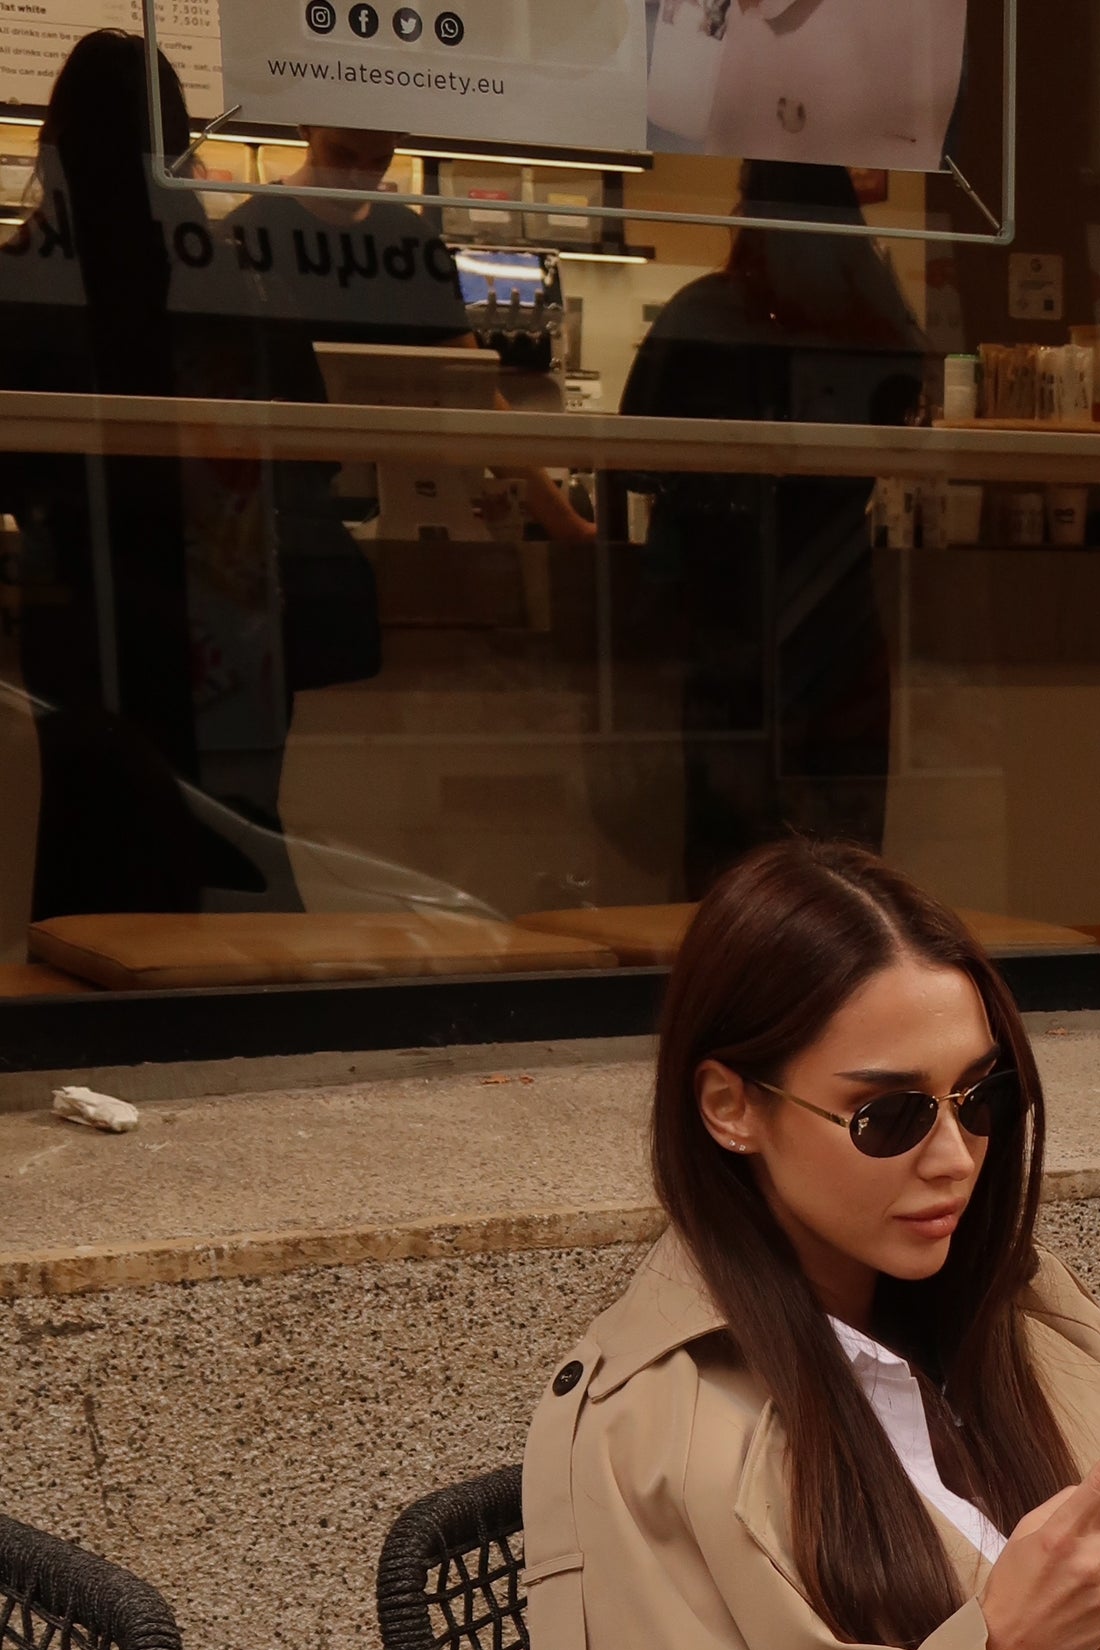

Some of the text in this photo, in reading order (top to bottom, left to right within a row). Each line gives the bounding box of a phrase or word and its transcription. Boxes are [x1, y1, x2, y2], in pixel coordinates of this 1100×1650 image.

[0, 2, 46, 15] lat white
[267, 59, 505, 95] www.latesociety.eu
